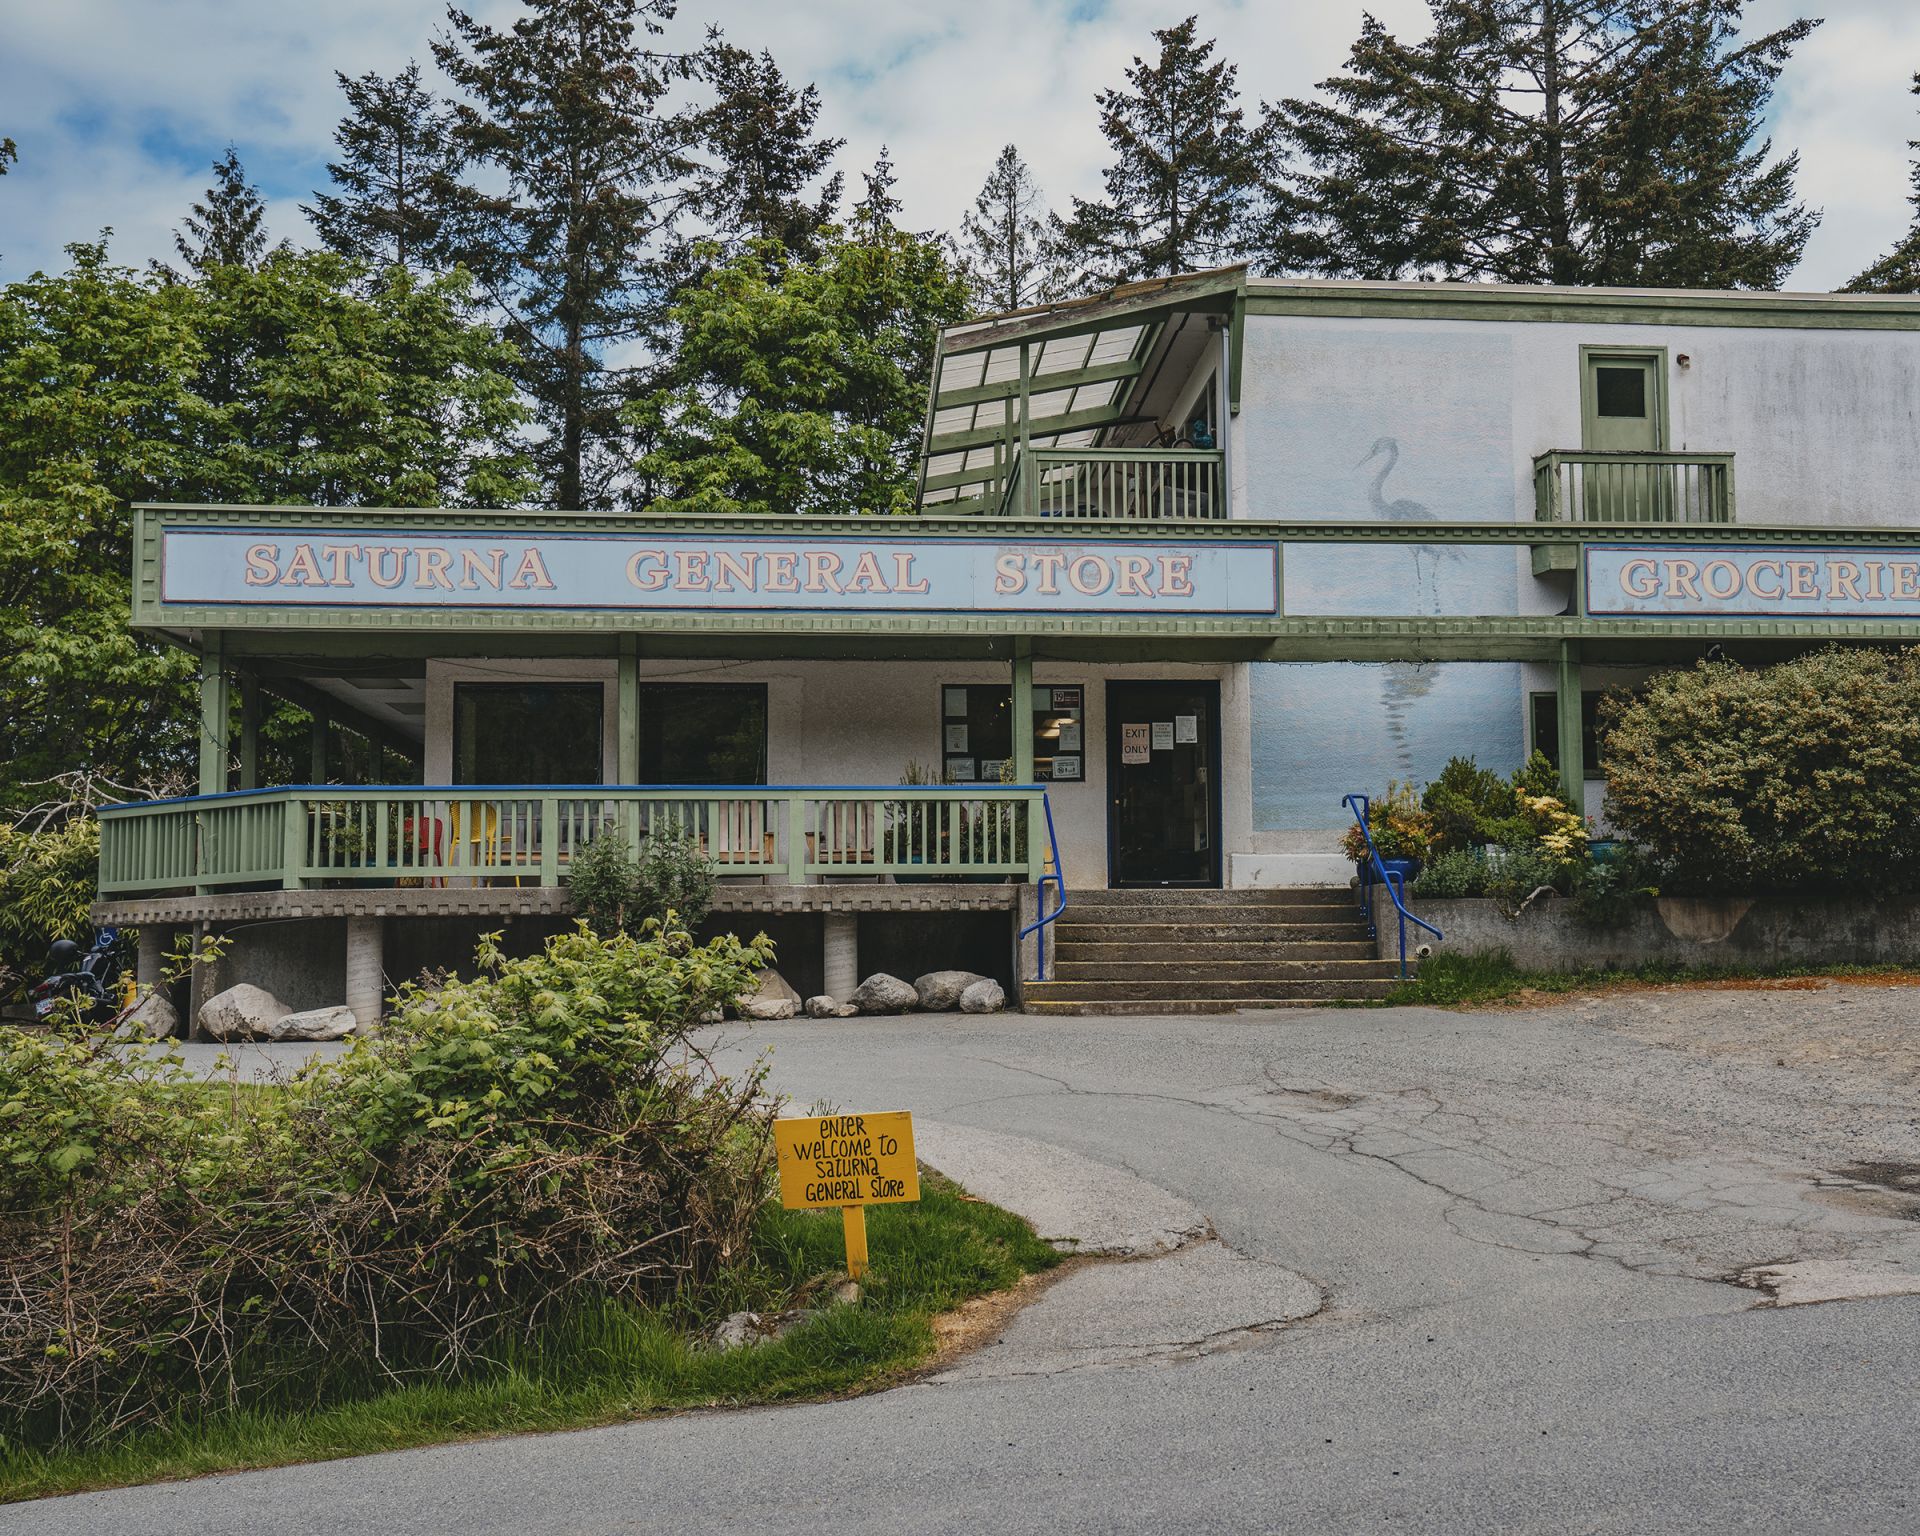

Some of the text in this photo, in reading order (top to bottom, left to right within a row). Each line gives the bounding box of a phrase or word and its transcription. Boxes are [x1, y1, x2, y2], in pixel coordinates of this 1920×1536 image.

[245, 543, 1195, 597] SATURNA GENERAL STORE
[1619, 558, 1920, 601] GROCERIE
[1125, 728, 1147, 738] EXIT
[1124, 745, 1148, 754] ONLY
